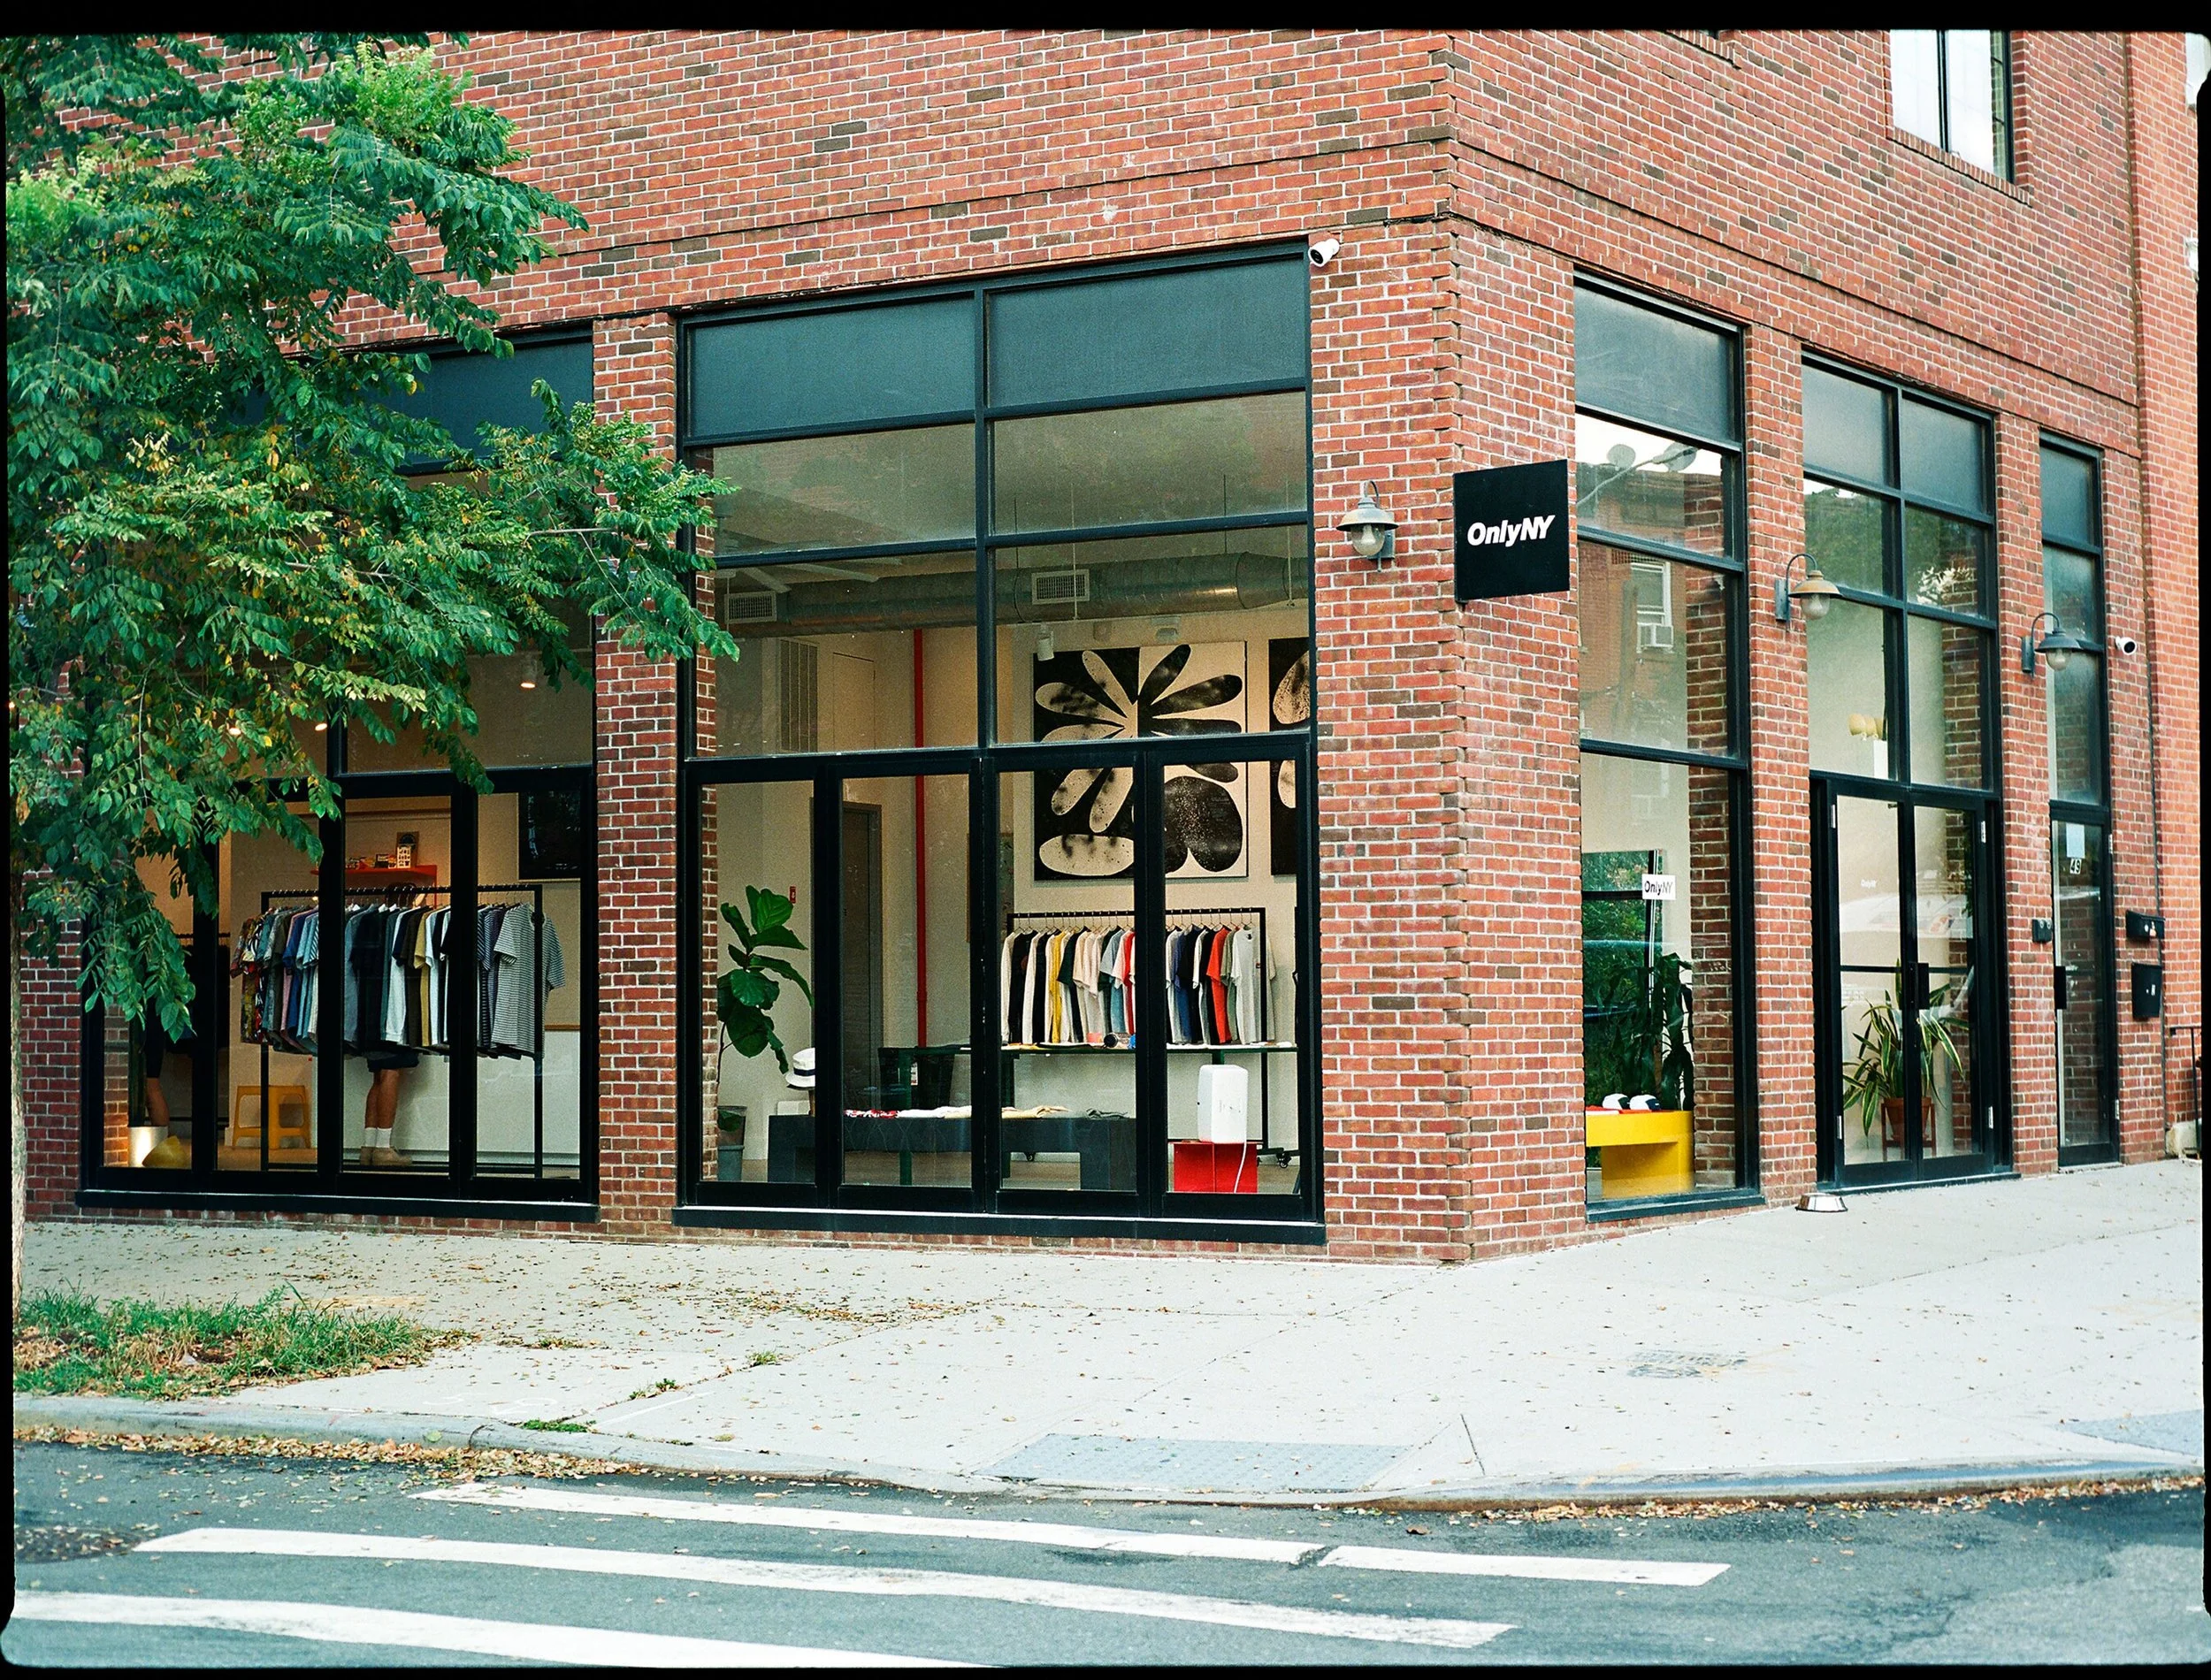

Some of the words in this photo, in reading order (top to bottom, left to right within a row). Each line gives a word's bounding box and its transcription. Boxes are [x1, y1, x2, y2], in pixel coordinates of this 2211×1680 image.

[1467, 515, 1556, 547] OnlyNY
[2070, 859, 2081, 874] 49
[1644, 881, 1673, 896] OnlyNY
